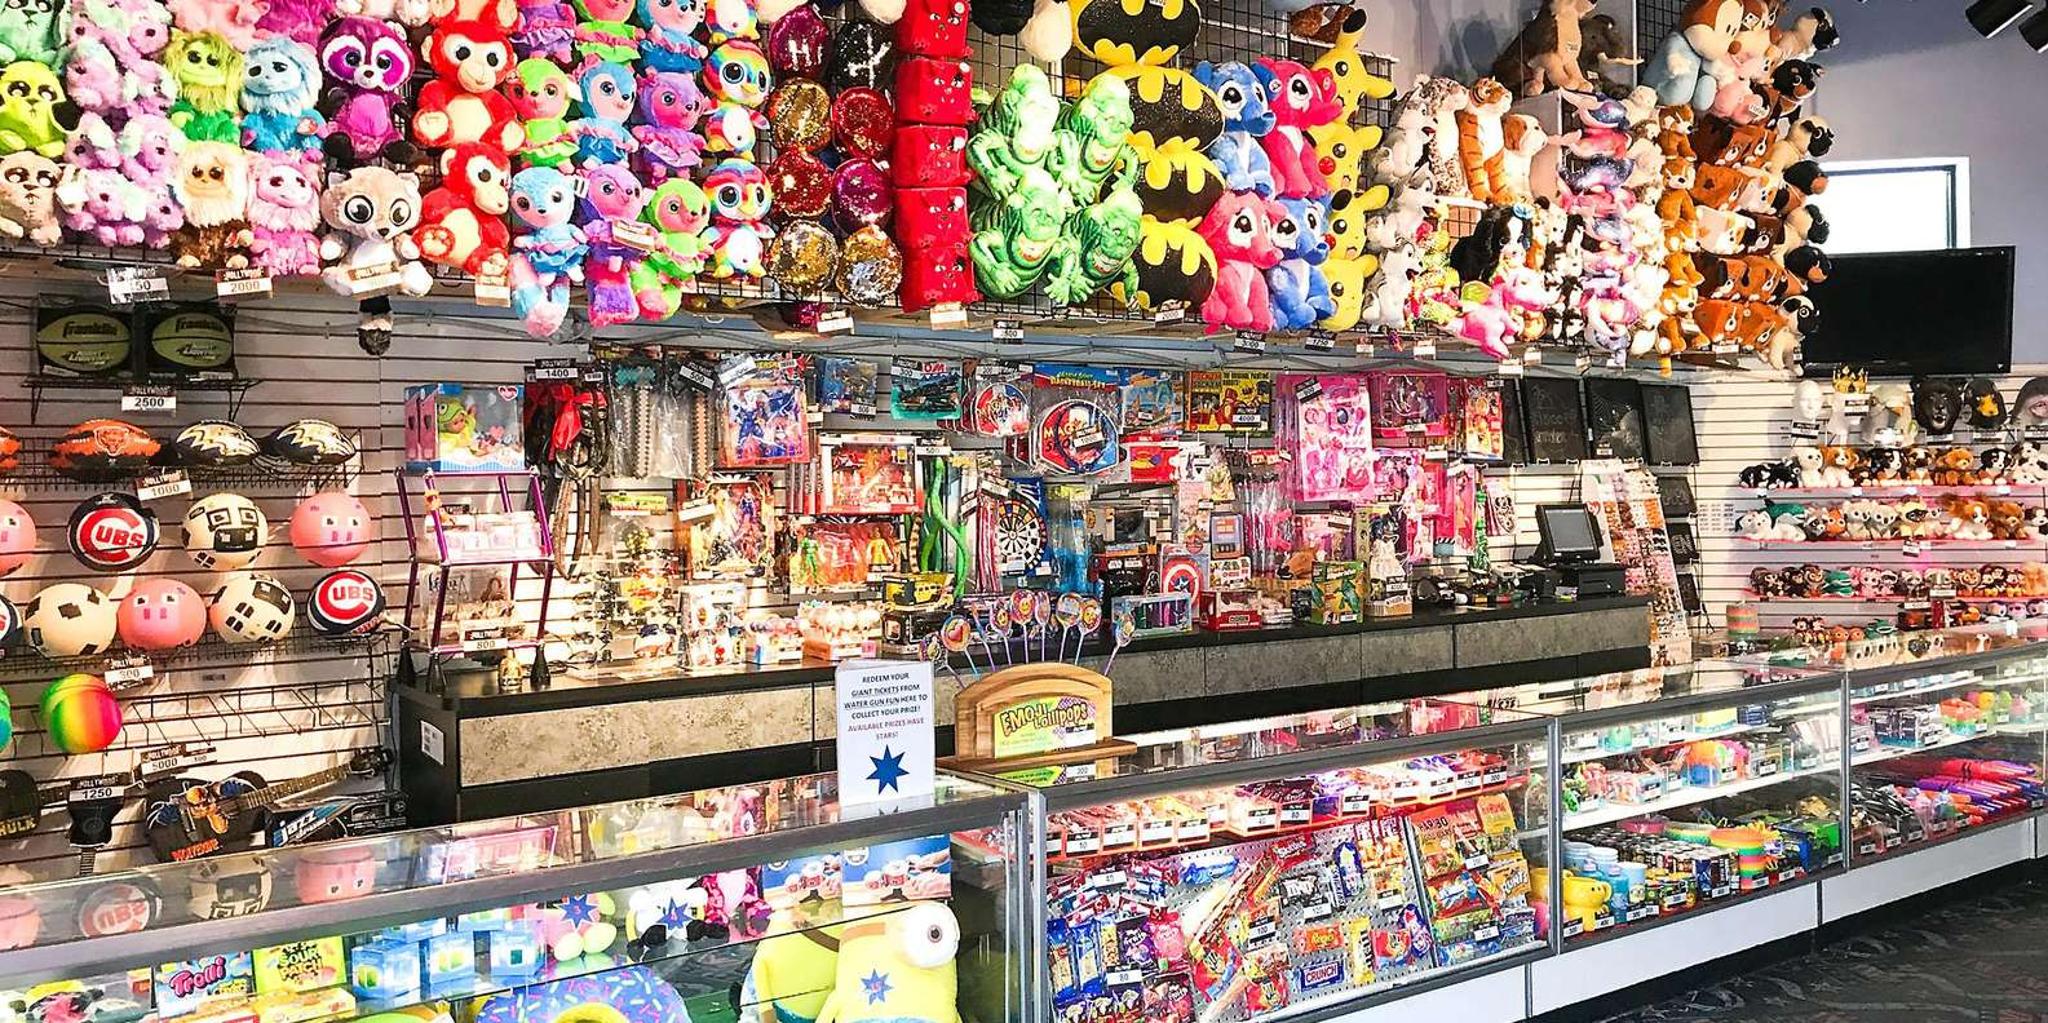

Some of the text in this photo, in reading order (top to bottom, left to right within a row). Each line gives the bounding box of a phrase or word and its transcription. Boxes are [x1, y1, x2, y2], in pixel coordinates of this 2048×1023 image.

[545, 369, 569, 378] 1400
[135, 397, 165, 407] 2500
[152, 485, 180, 496] 1000
[862, 672, 909, 683] REDEEM YOUR
[851, 688, 872, 697] GIANT
[874, 686, 899, 695] TICKETS
[844, 699, 868, 709] WATER
[870, 698, 885, 706] GUN
[886, 697, 899, 705] FUN
[900, 695, 916, 703] HERE
[851, 710, 879, 720] COLLECT
[881, 708, 899, 717] YOUR
[999, 704, 1048, 736] EMOJI
[848, 717, 924, 732] AVAILABLE PRIZES HAVE
[82, 788, 112, 799] 1250
[278, 809, 316, 845] jazz
[279, 947, 318, 967] SOUR
[169, 953, 227, 998] Trolli
[280, 959, 323, 981] PATCH
[1307, 964, 1338, 983] CRUNCH
